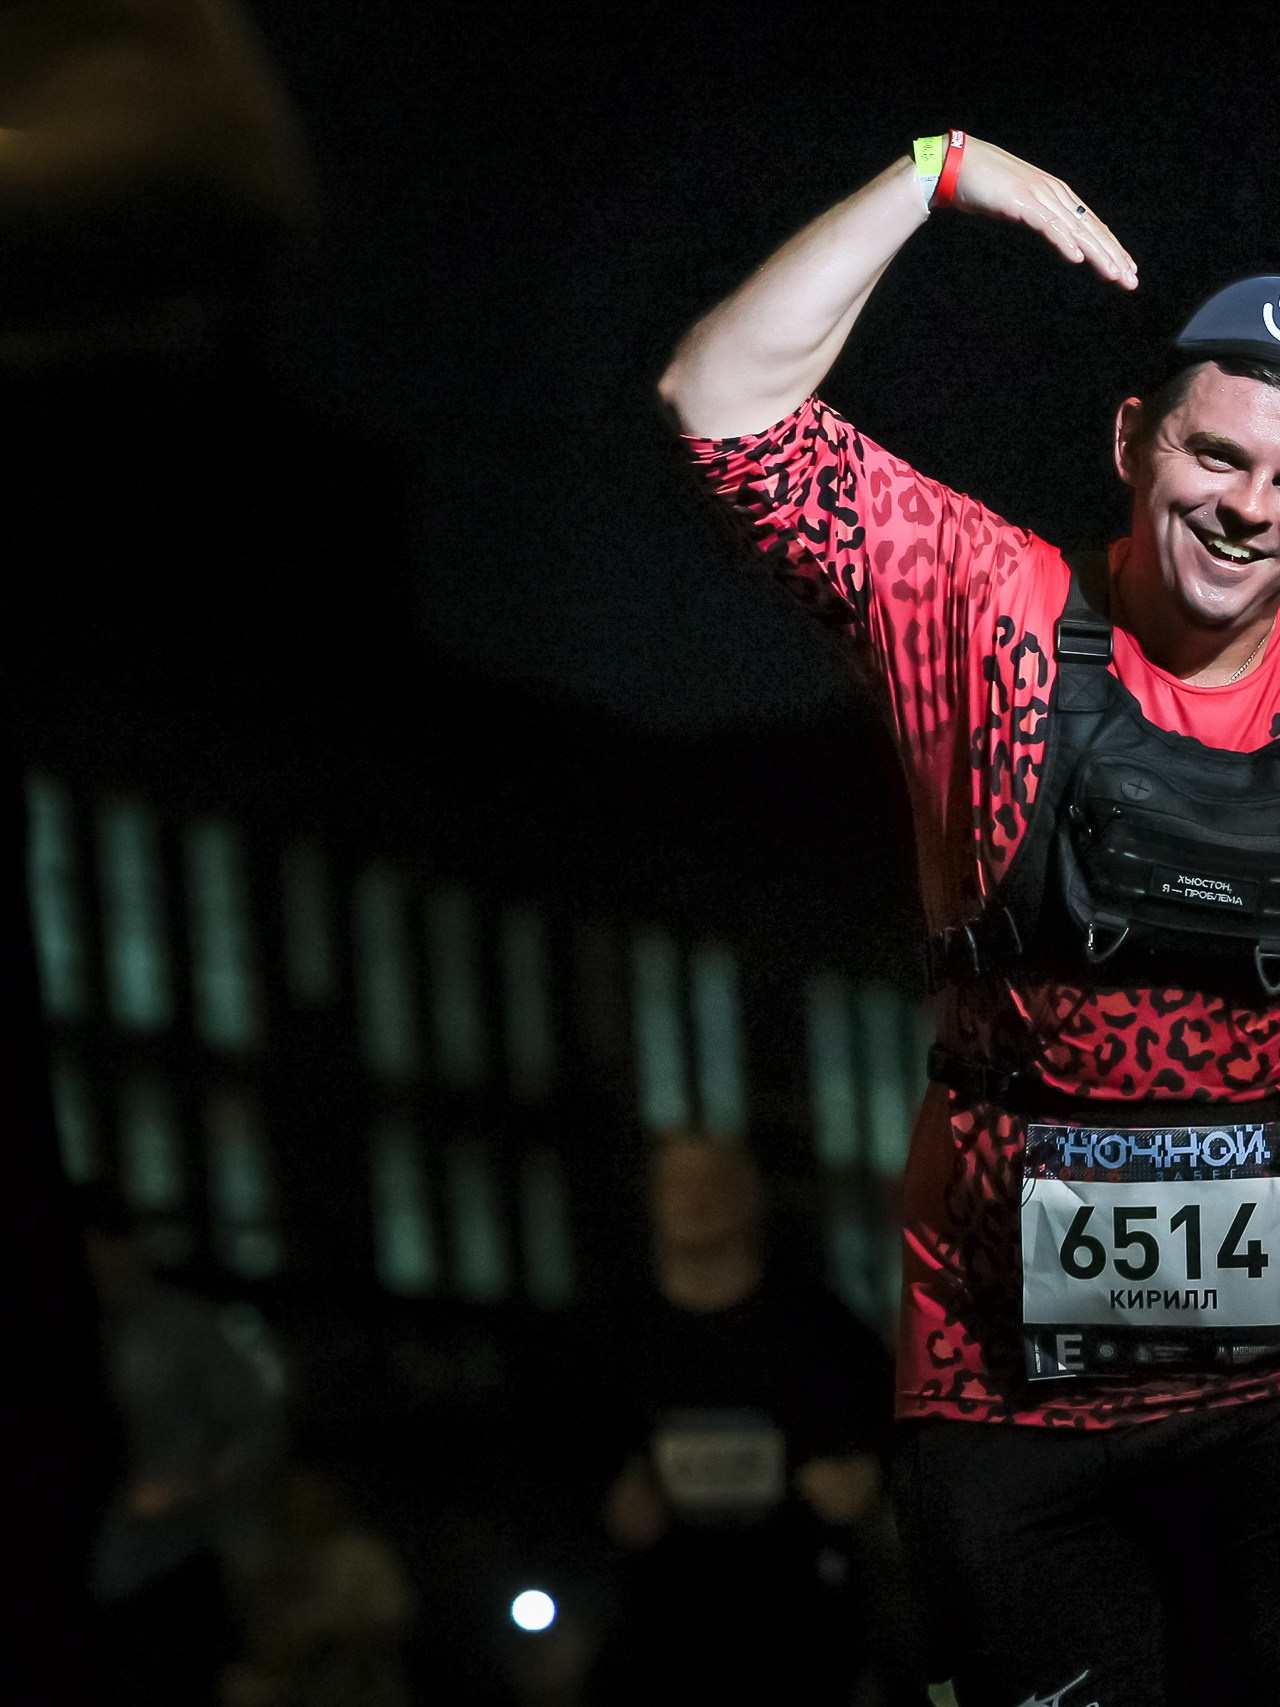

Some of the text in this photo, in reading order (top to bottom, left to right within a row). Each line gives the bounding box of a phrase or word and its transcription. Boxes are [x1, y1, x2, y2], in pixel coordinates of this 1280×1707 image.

[1162, 883, 1170, 893] Я
[1184, 888, 1243, 906] ПРОБЛЕМА
[1177, 874, 1233, 894] ХЬЮСТОН,
[1057, 1125, 1269, 1168] НОЧНОЙ
[1059, 1202, 1269, 1281] 6514
[1109, 1289, 1218, 1310] КИРИЛЛ
